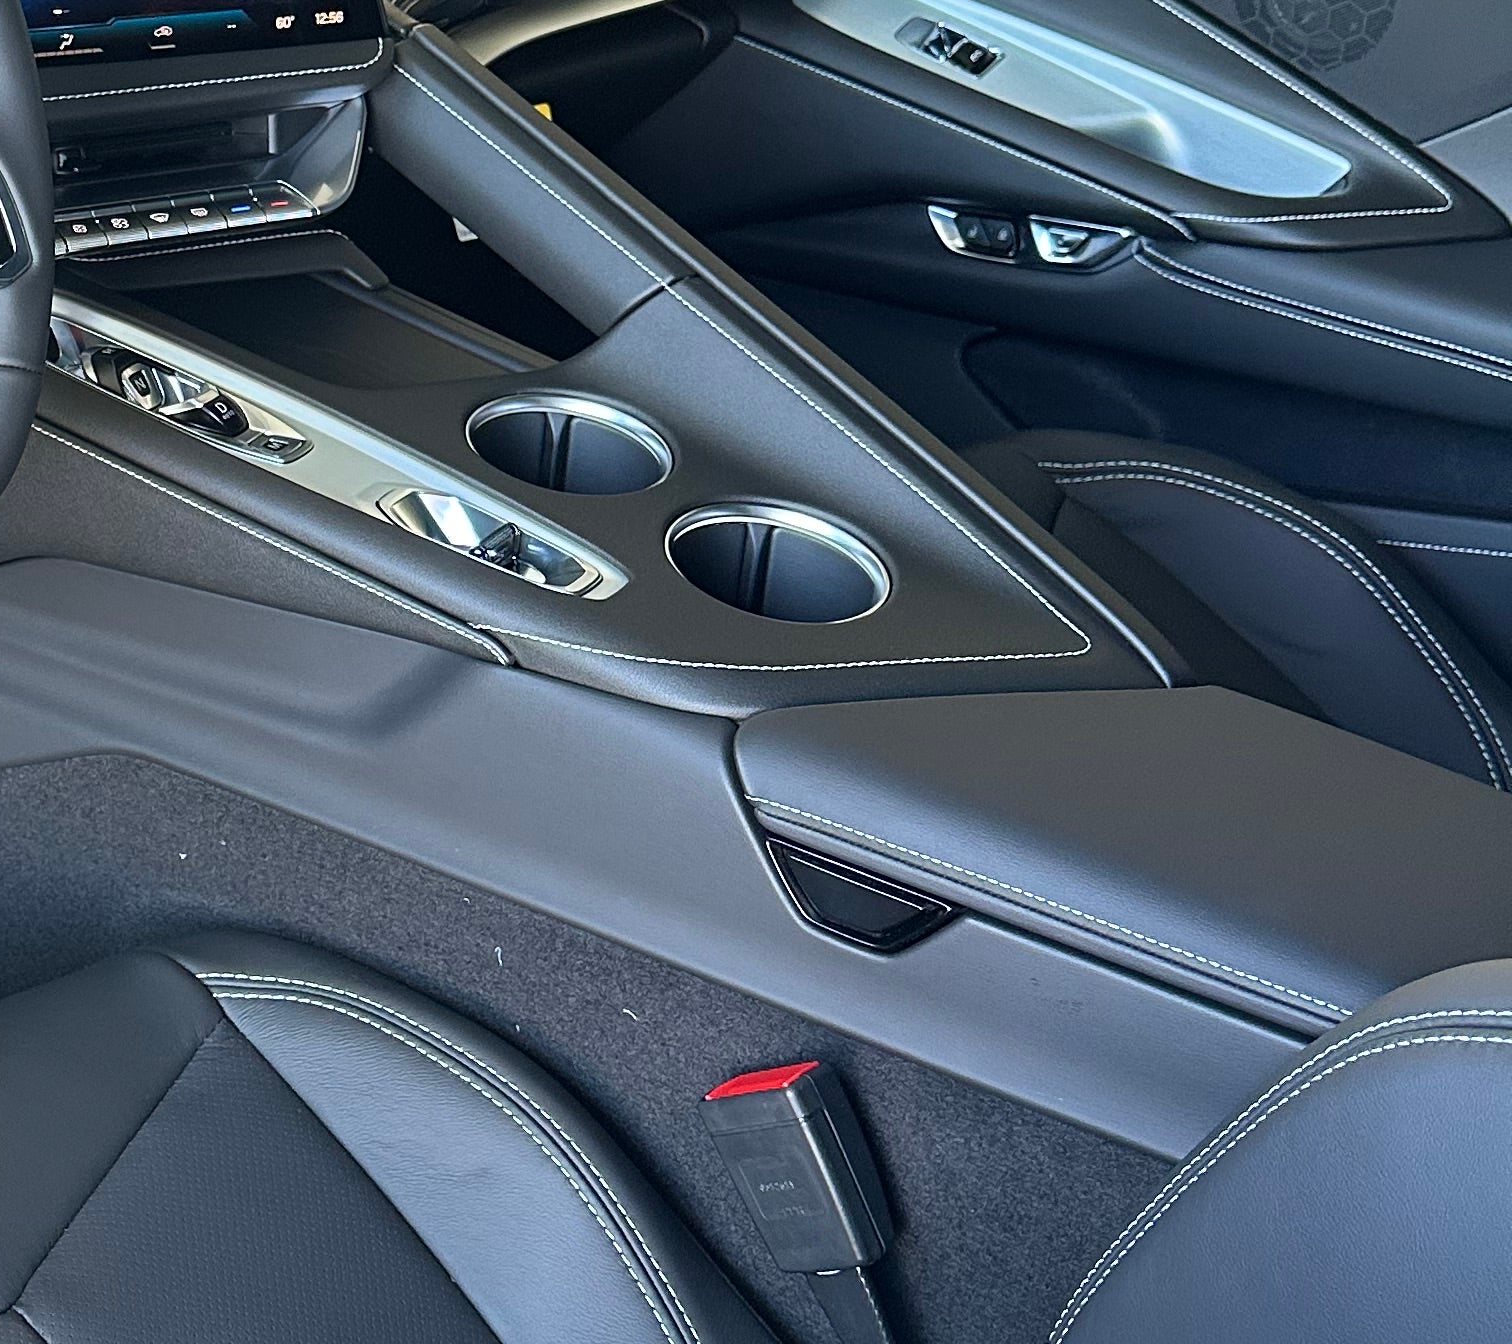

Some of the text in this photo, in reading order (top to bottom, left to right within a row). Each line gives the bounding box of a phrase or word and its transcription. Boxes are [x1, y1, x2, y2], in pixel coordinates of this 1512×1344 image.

[275, 10, 344, 30] 60° 12:56
[134, 377, 147, 391] N
[214, 402, 228, 414] D
